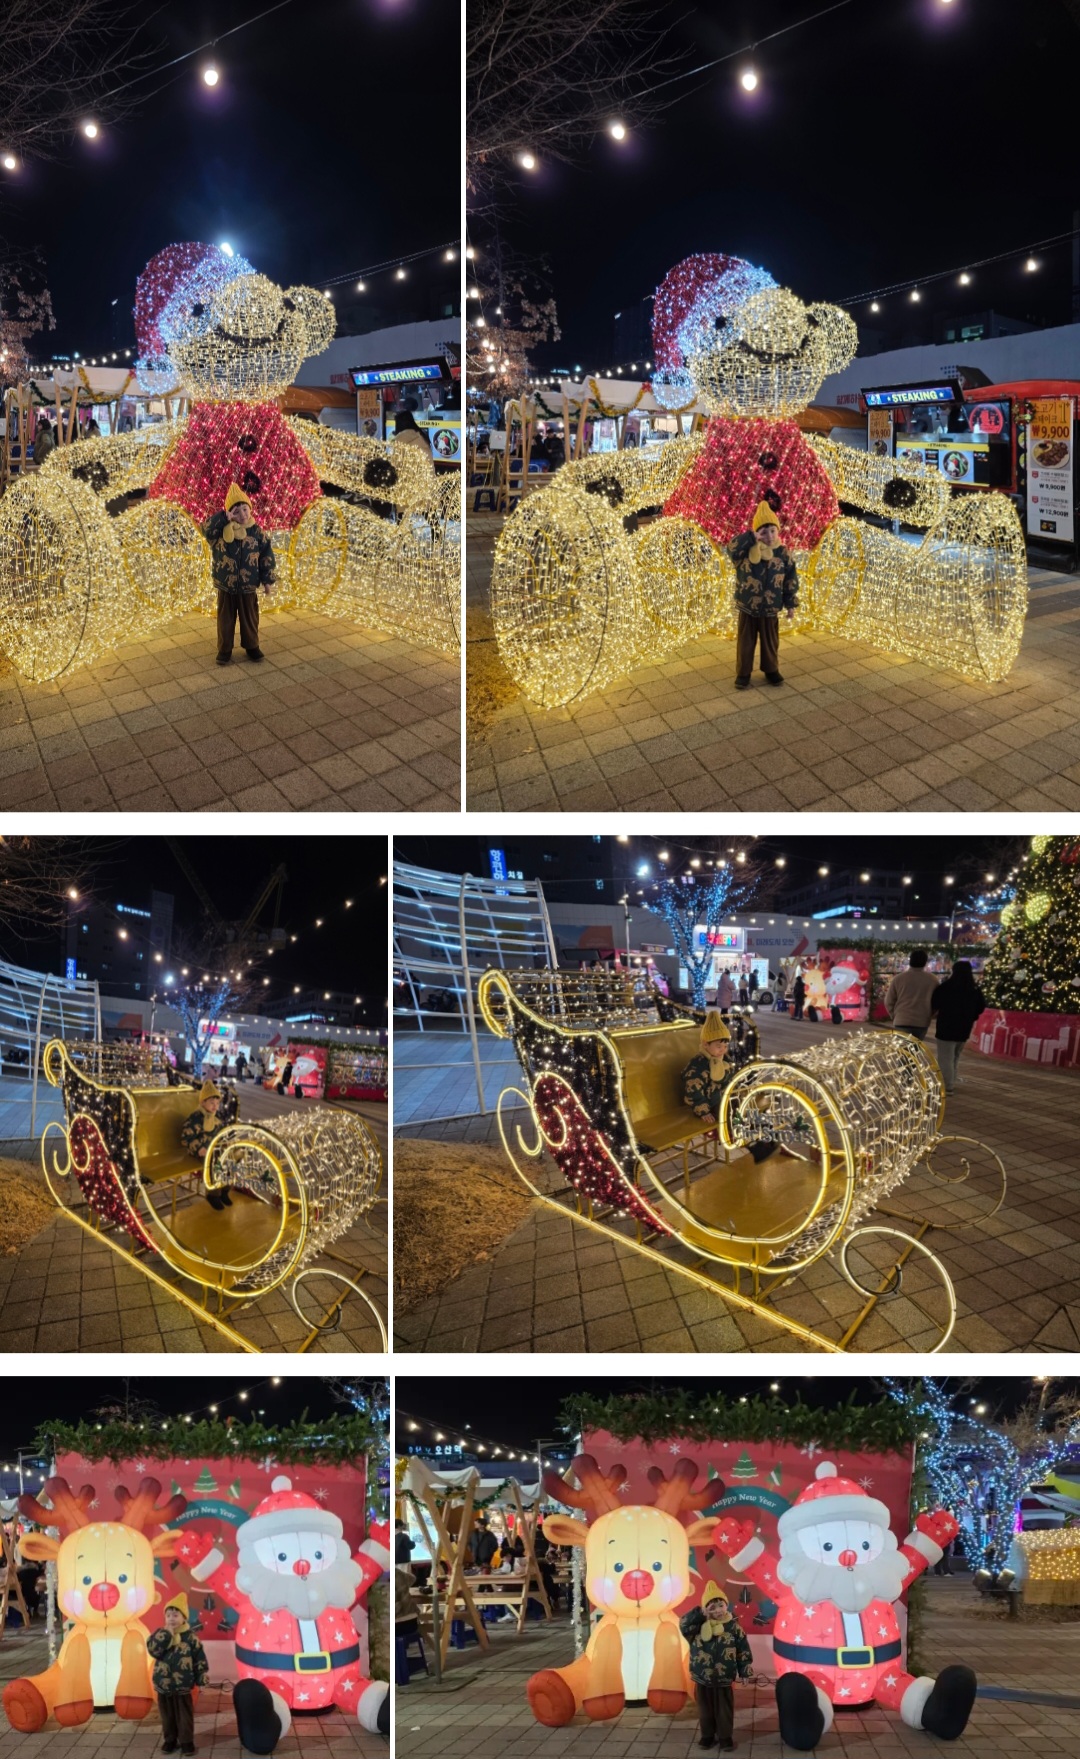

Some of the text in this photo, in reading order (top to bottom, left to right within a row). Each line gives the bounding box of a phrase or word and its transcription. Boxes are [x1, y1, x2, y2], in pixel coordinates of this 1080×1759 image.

[378, 369, 426, 382] STEAKING
[891, 390, 939, 403] STEAKING
[435, 1445, 463, 1455] 오산역
[739, 1493, 757, 1501] New
[760, 1495, 777, 1508] Year
[200, 1506, 218, 1514] New
[220, 1507, 237, 1519] Year
